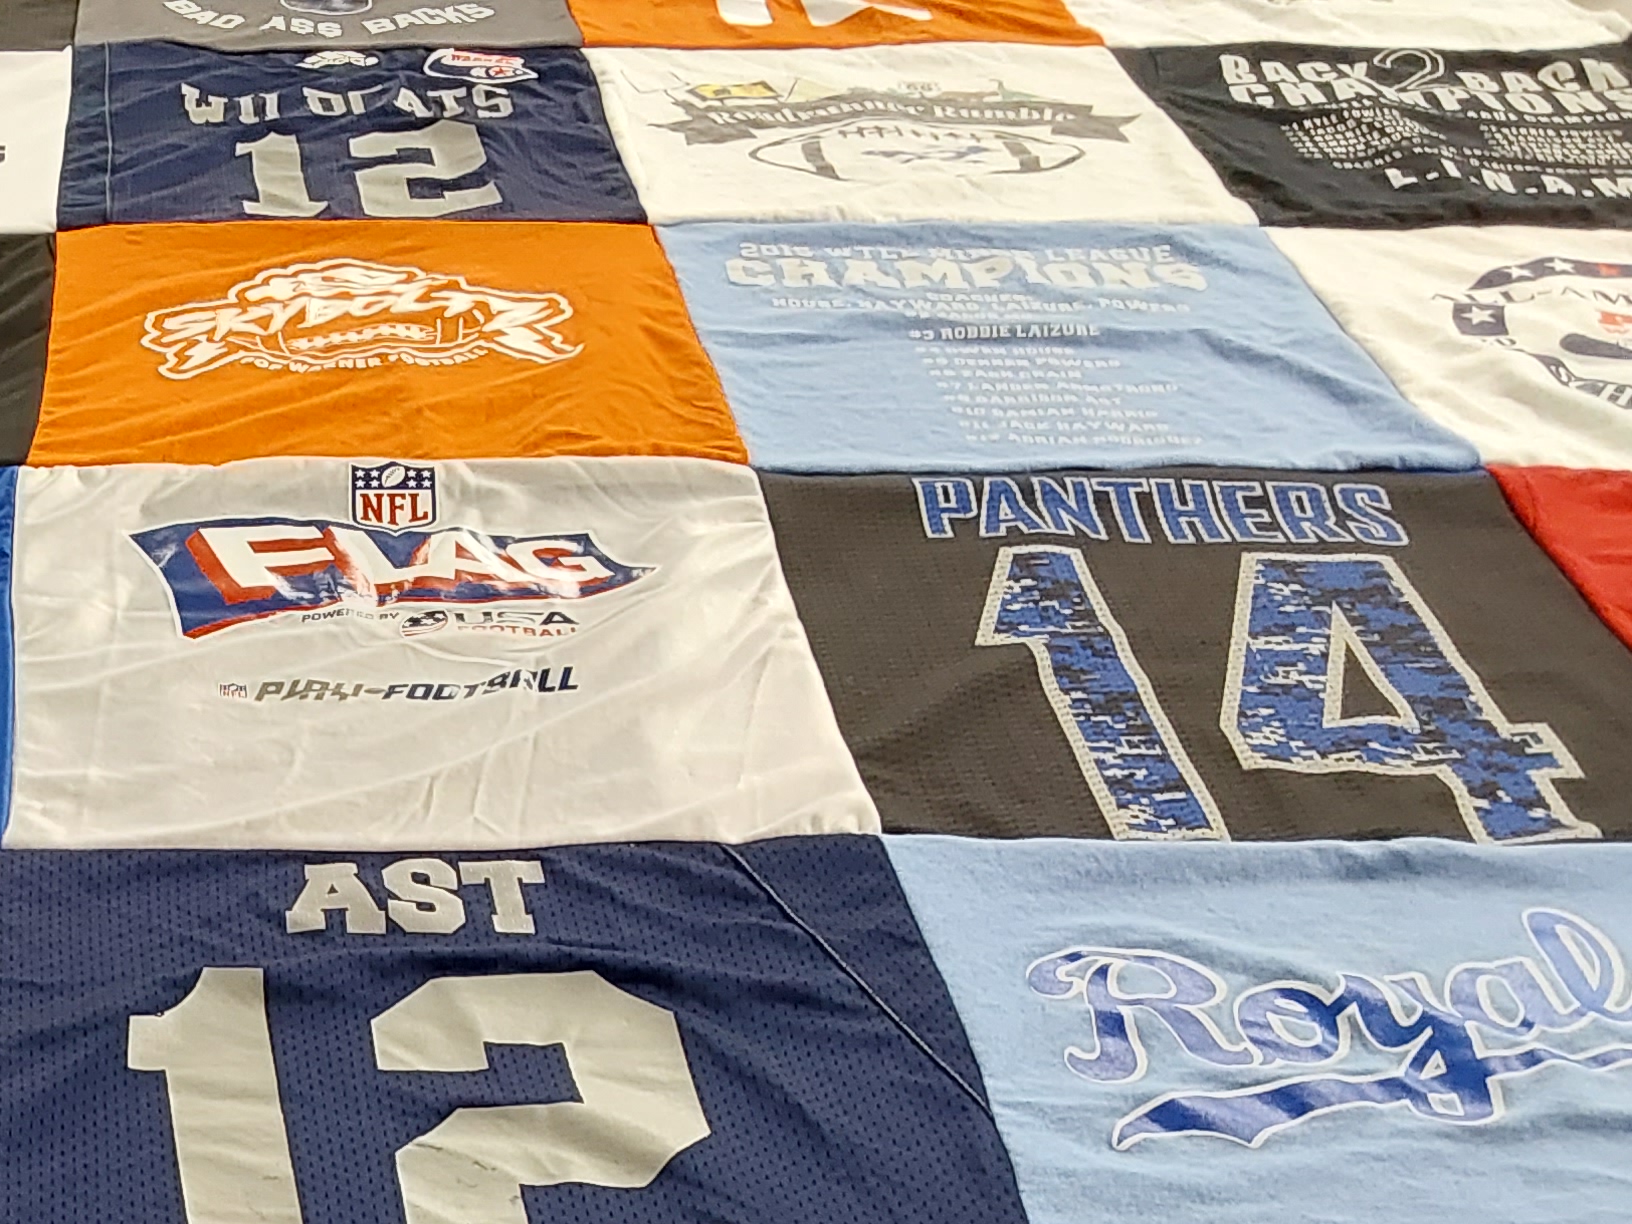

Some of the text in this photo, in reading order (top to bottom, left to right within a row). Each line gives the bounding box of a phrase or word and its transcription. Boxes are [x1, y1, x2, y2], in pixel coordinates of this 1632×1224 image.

[162, 0, 496, 39] BAD ASS BACKS
[1219, 54, 1369, 85] BACK
[1453, 57, 1631, 93] BACK
[234, 119, 504, 218] 12
[1044, 244, 1175, 262] LEAGUE
[725, 257, 1209, 291] CHAMPIONS
[359, 492, 430, 527] NFL
[911, 476, 1410, 547] PANTHERS
[186, 523, 616, 606] FLAG
[454, 610, 580, 626] USA
[972, 544, 1606, 845] 14
[285, 857, 546, 935] AST
